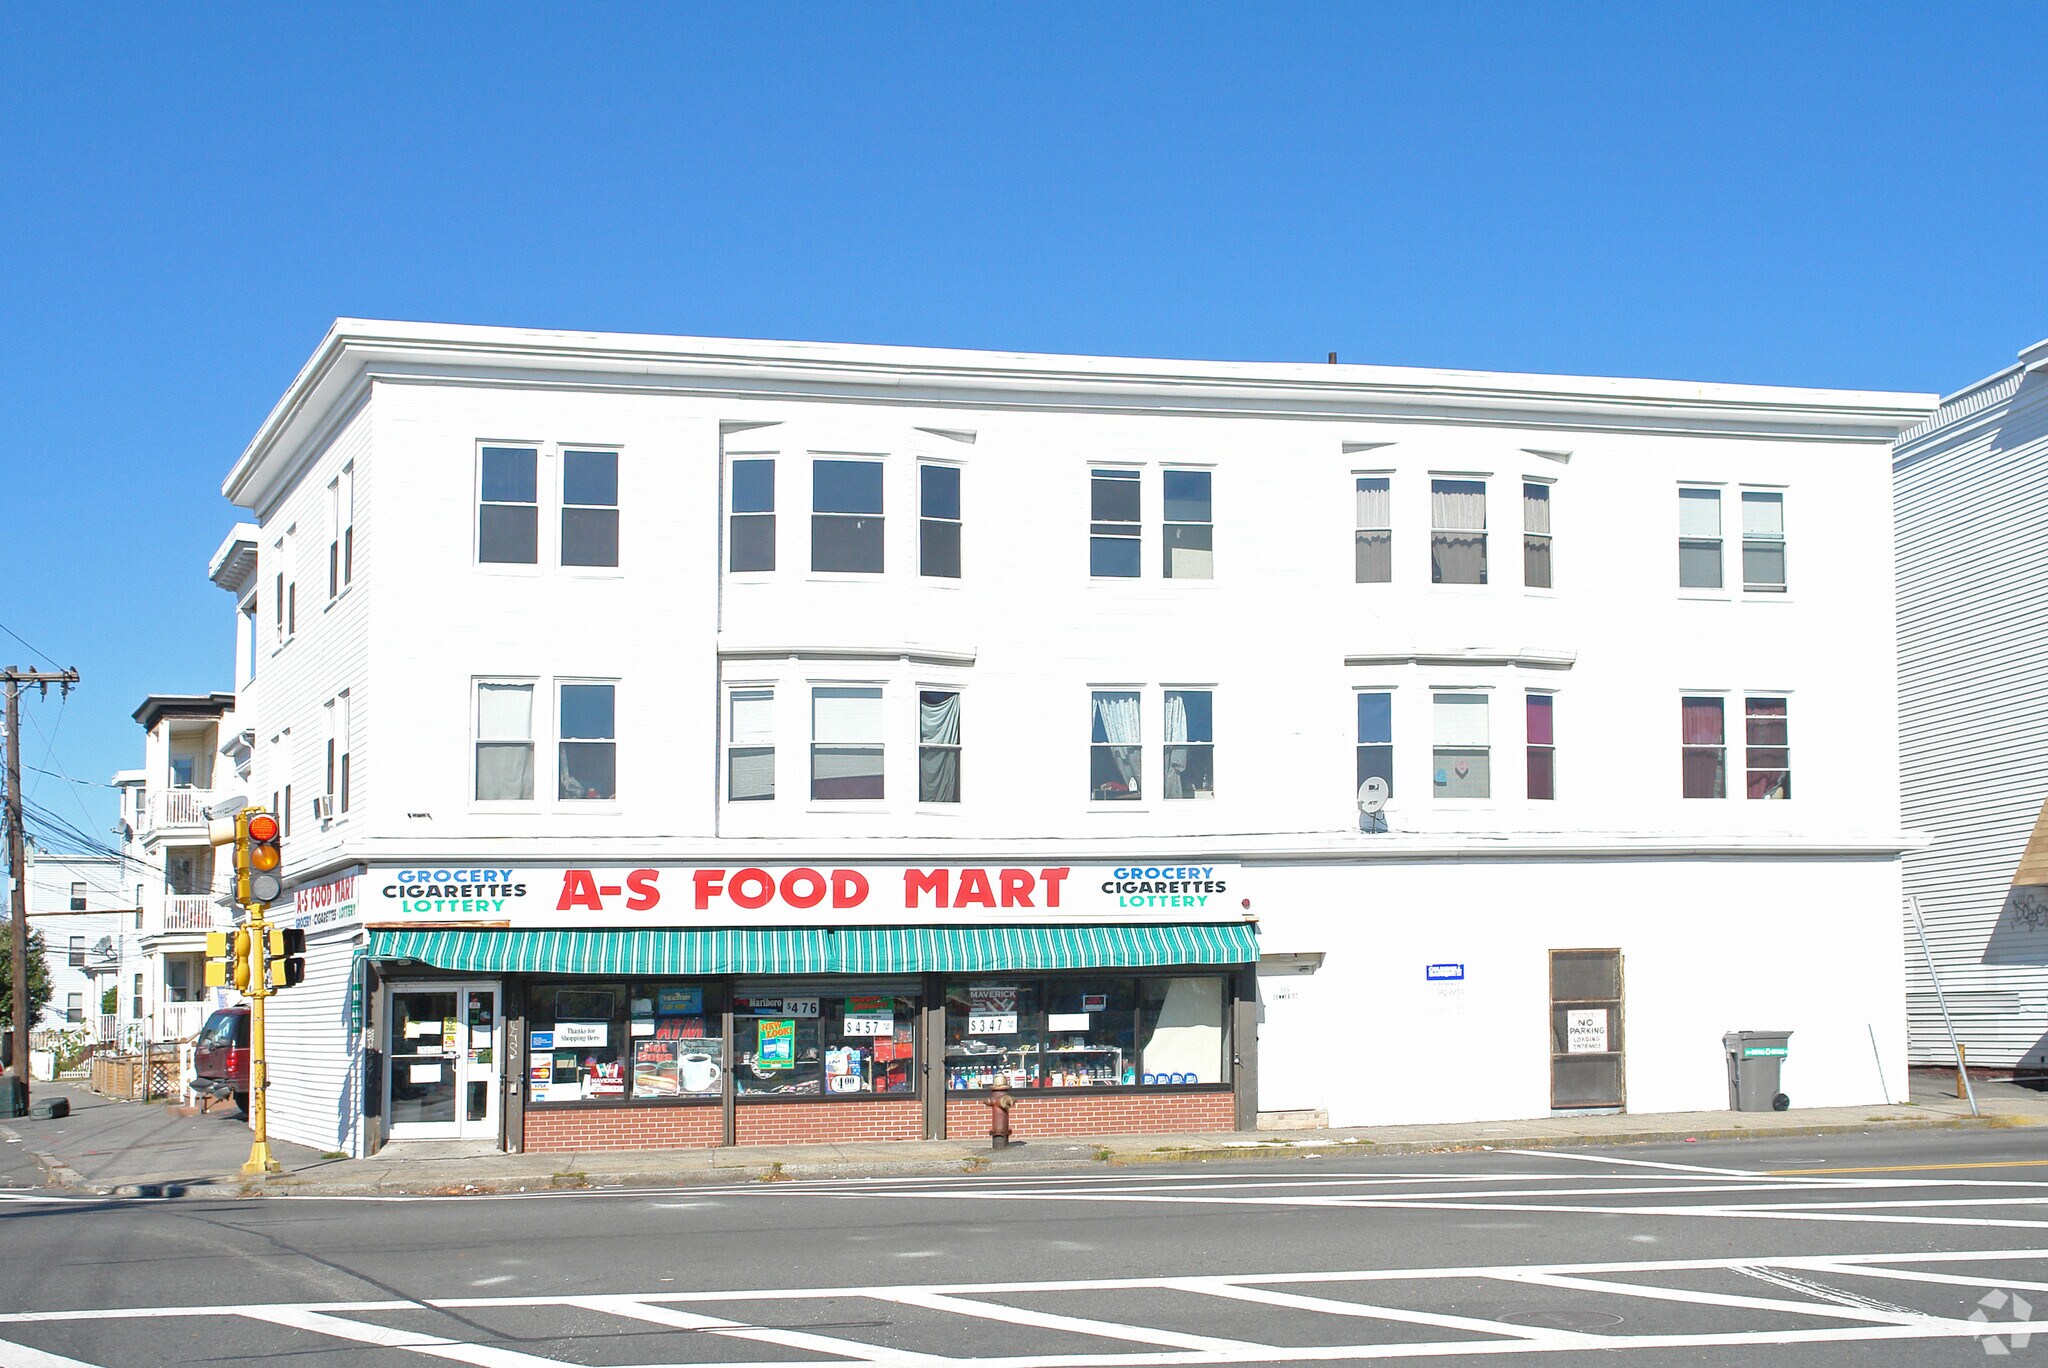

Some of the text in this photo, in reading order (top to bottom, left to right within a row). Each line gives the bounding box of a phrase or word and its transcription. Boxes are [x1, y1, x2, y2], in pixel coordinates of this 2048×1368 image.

[397, 869, 513, 883] GROCERY
[1113, 867, 1213, 880] GROCERY
[297, 873, 355, 914] A-S FOOD MART
[382, 884, 527, 898] CIGARETTES
[556, 867, 1070, 911] A-S FOOD MART
[1101, 881, 1227, 894] CIGARETTES
[403, 899, 505, 912] LOTTERY
[1119, 895, 1208, 907] LOTTERY
[338, 903, 356, 919] LOTTERY
[749, 998, 782, 1006] Marlboro
[656, 1017, 703, 1040] ATM
[761, 1021, 781, 1031] NEW
[766, 1027, 792, 1038] LOOK!
[643, 1042, 668, 1053] Hot
[637, 1052, 673, 1062] Dogs
